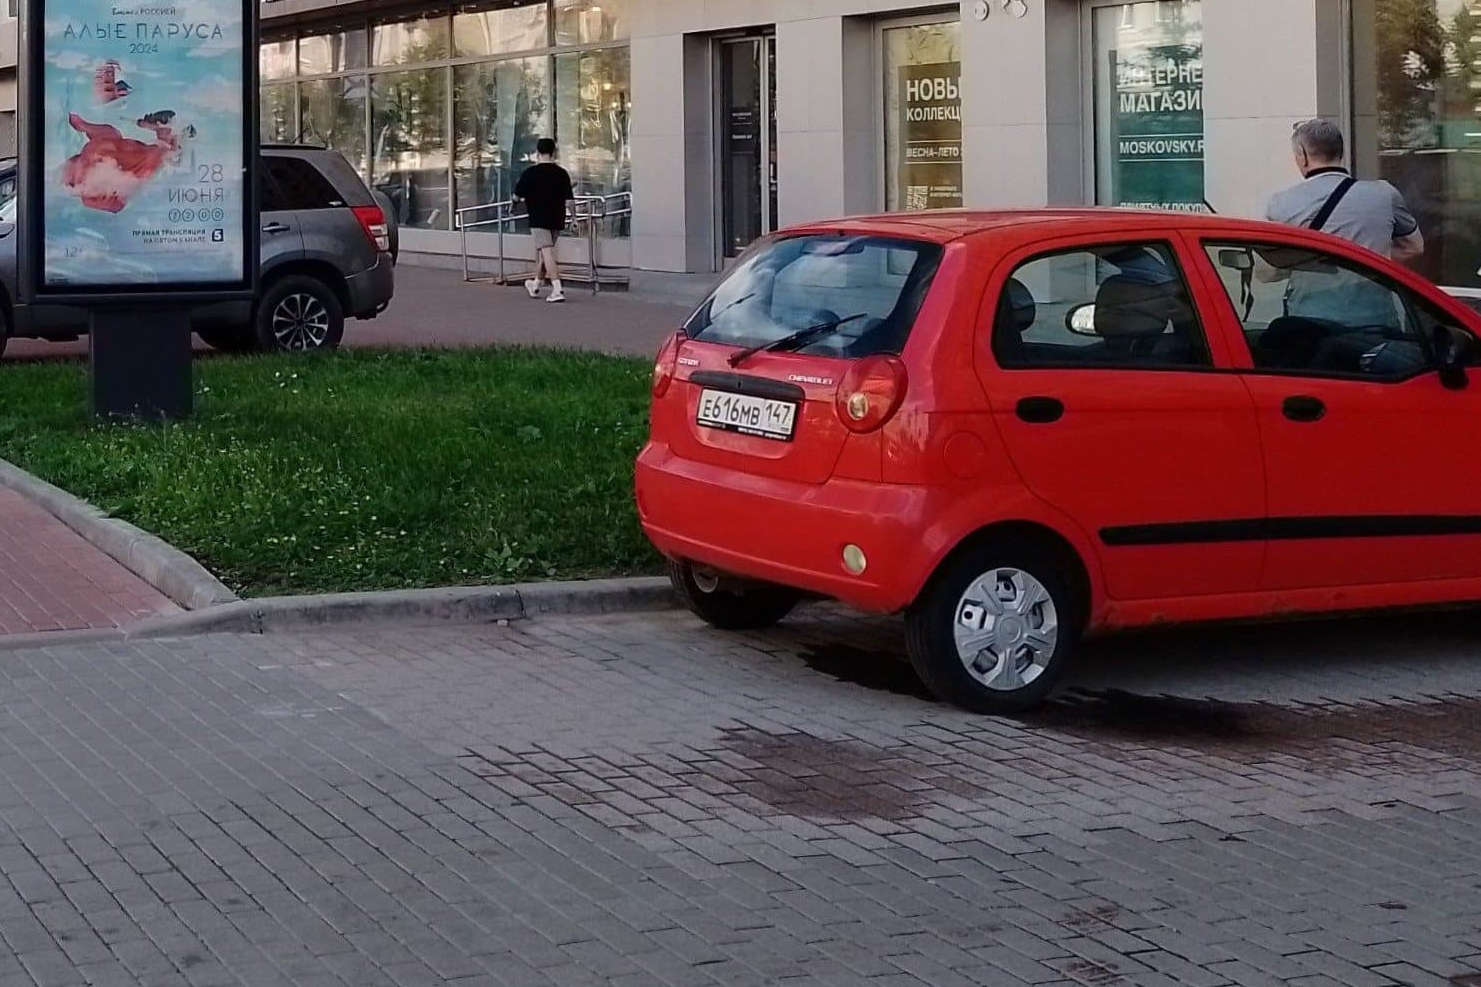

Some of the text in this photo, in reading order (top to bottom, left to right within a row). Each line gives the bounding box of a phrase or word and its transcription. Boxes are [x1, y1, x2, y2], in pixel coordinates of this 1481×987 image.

[64, 23, 223, 39] АЛЫЕ ПАРУСА
[130, 43, 159, 54] 2024
[906, 106, 961, 122] КОЛЛЕКЦ
[198, 164, 224, 183] 28
[169, 188, 224, 203] ИЮНЯ
[765, 403, 791, 424] 147
